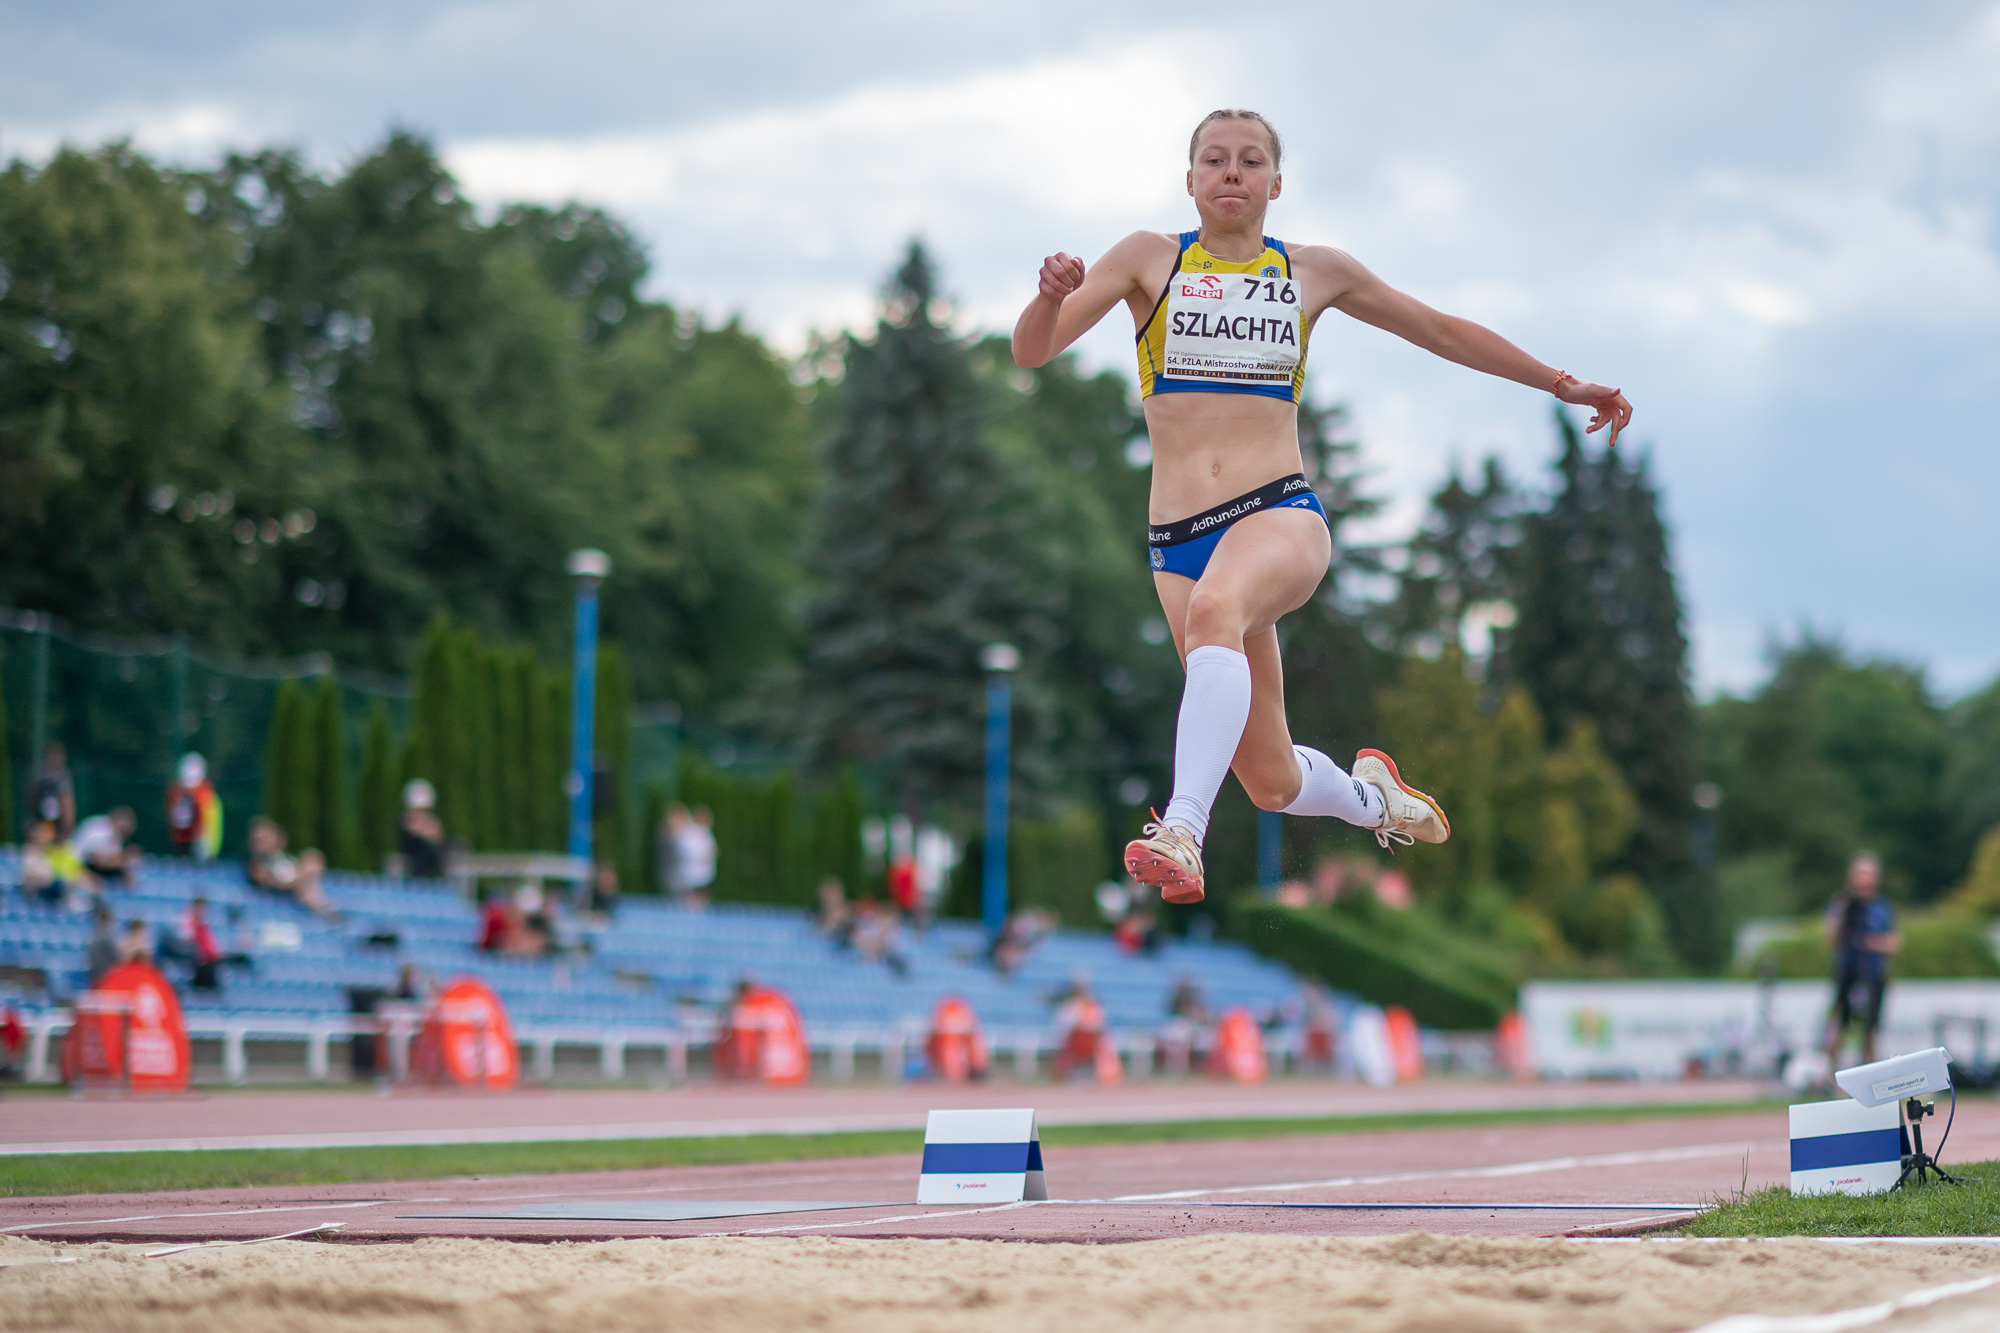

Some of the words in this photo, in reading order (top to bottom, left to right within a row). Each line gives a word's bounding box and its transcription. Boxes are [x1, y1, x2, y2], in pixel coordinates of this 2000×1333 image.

[1184, 285, 1221, 299] ORLEN
[1243, 278, 1297, 304] 716
[1171, 311, 1296, 346] SZLACHTA
[1167, 356, 1180, 365] 54.
[1182, 357, 1202, 366] PZLA
[1204, 359, 1254, 369] Mistrzostwa
[1255, 362, 1279, 371] Polski
[1190, 497, 1262, 534] AdRunaLine
